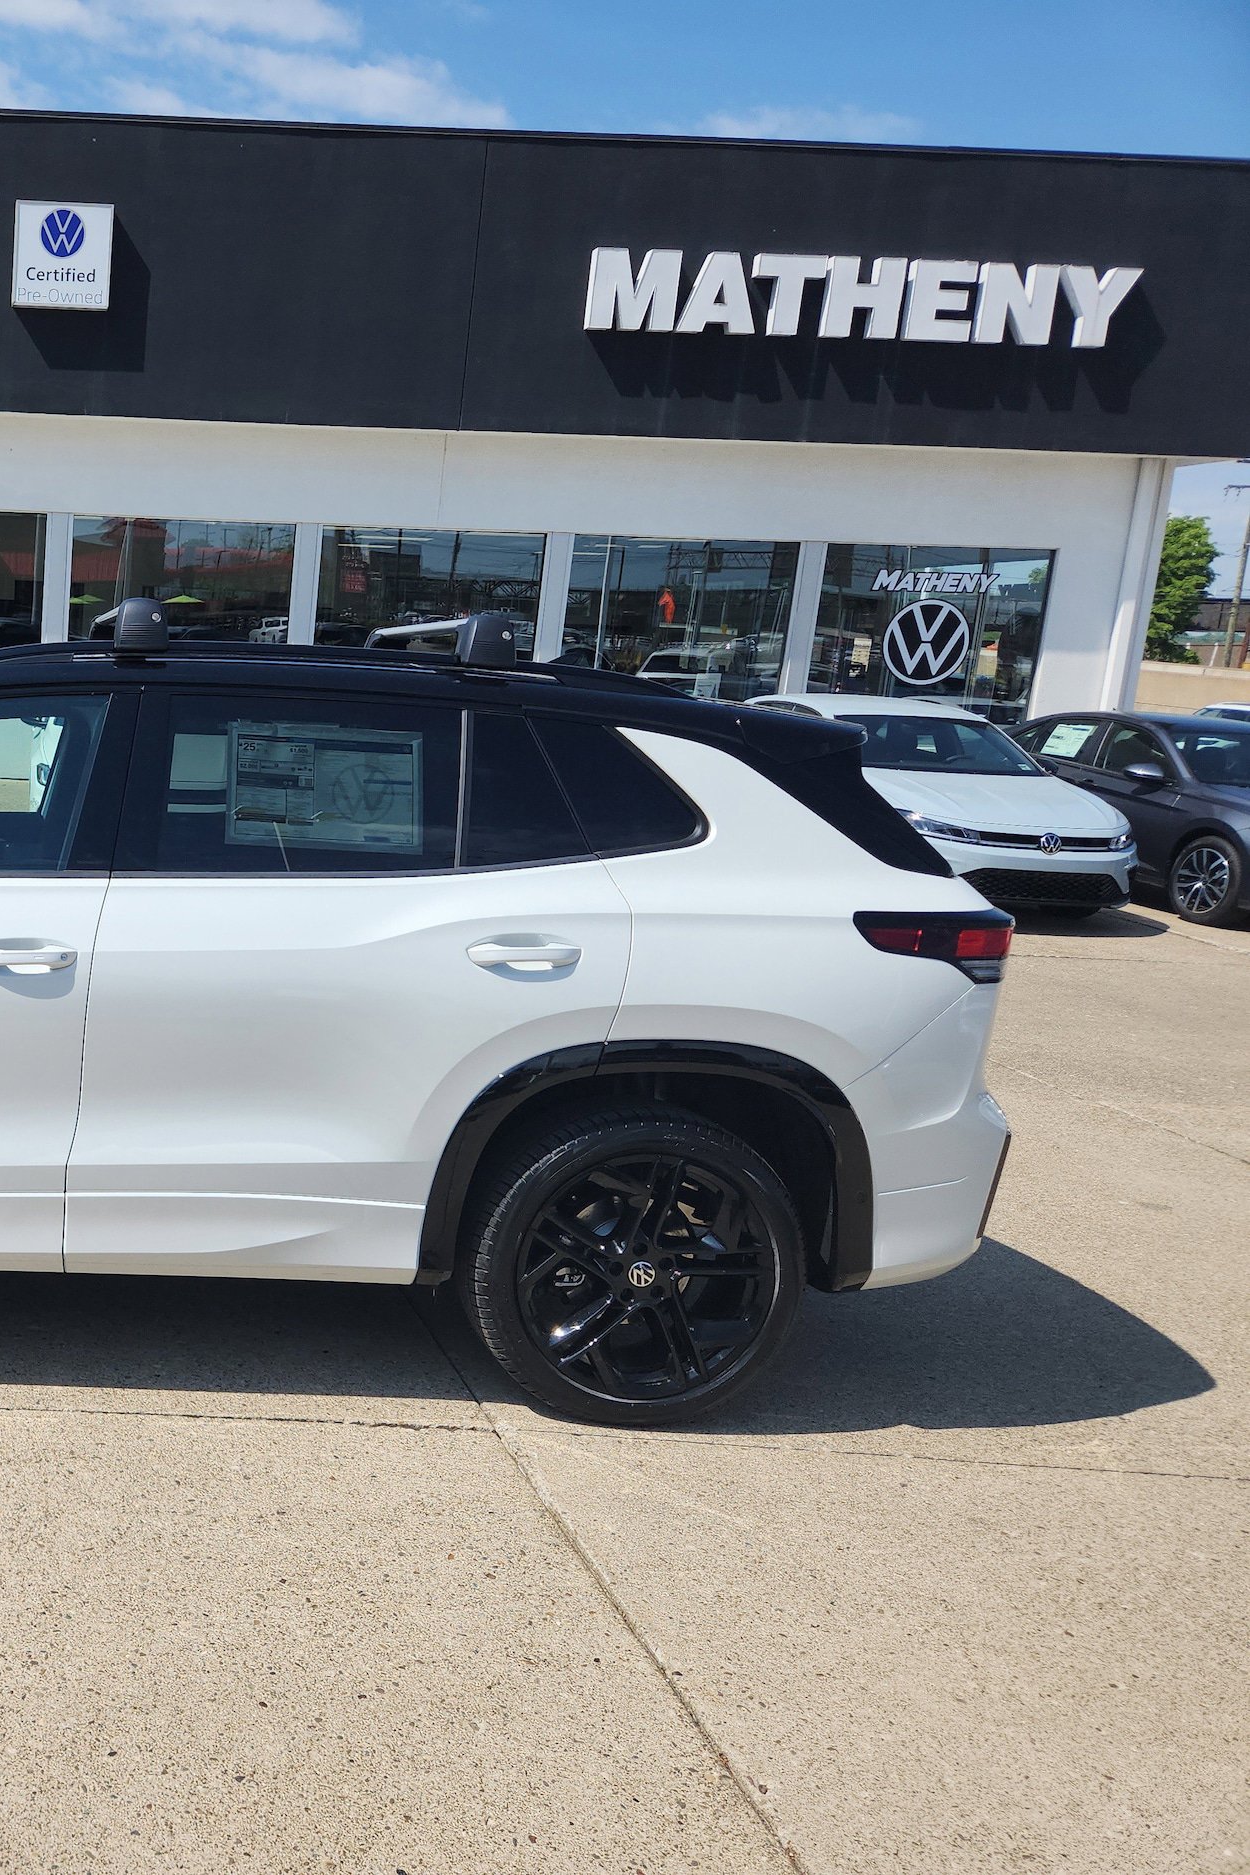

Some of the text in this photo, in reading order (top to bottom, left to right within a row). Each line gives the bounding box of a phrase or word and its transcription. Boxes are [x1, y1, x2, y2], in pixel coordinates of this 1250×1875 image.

[25, 266, 96, 283] Certified
[17, 287, 103, 305] Pre-Owned
[584, 246, 1145, 348] MATHENY
[871, 569, 1000, 593] MATHENY
[883, 598, 970, 685] VW
[243, 742, 256, 751] 25
